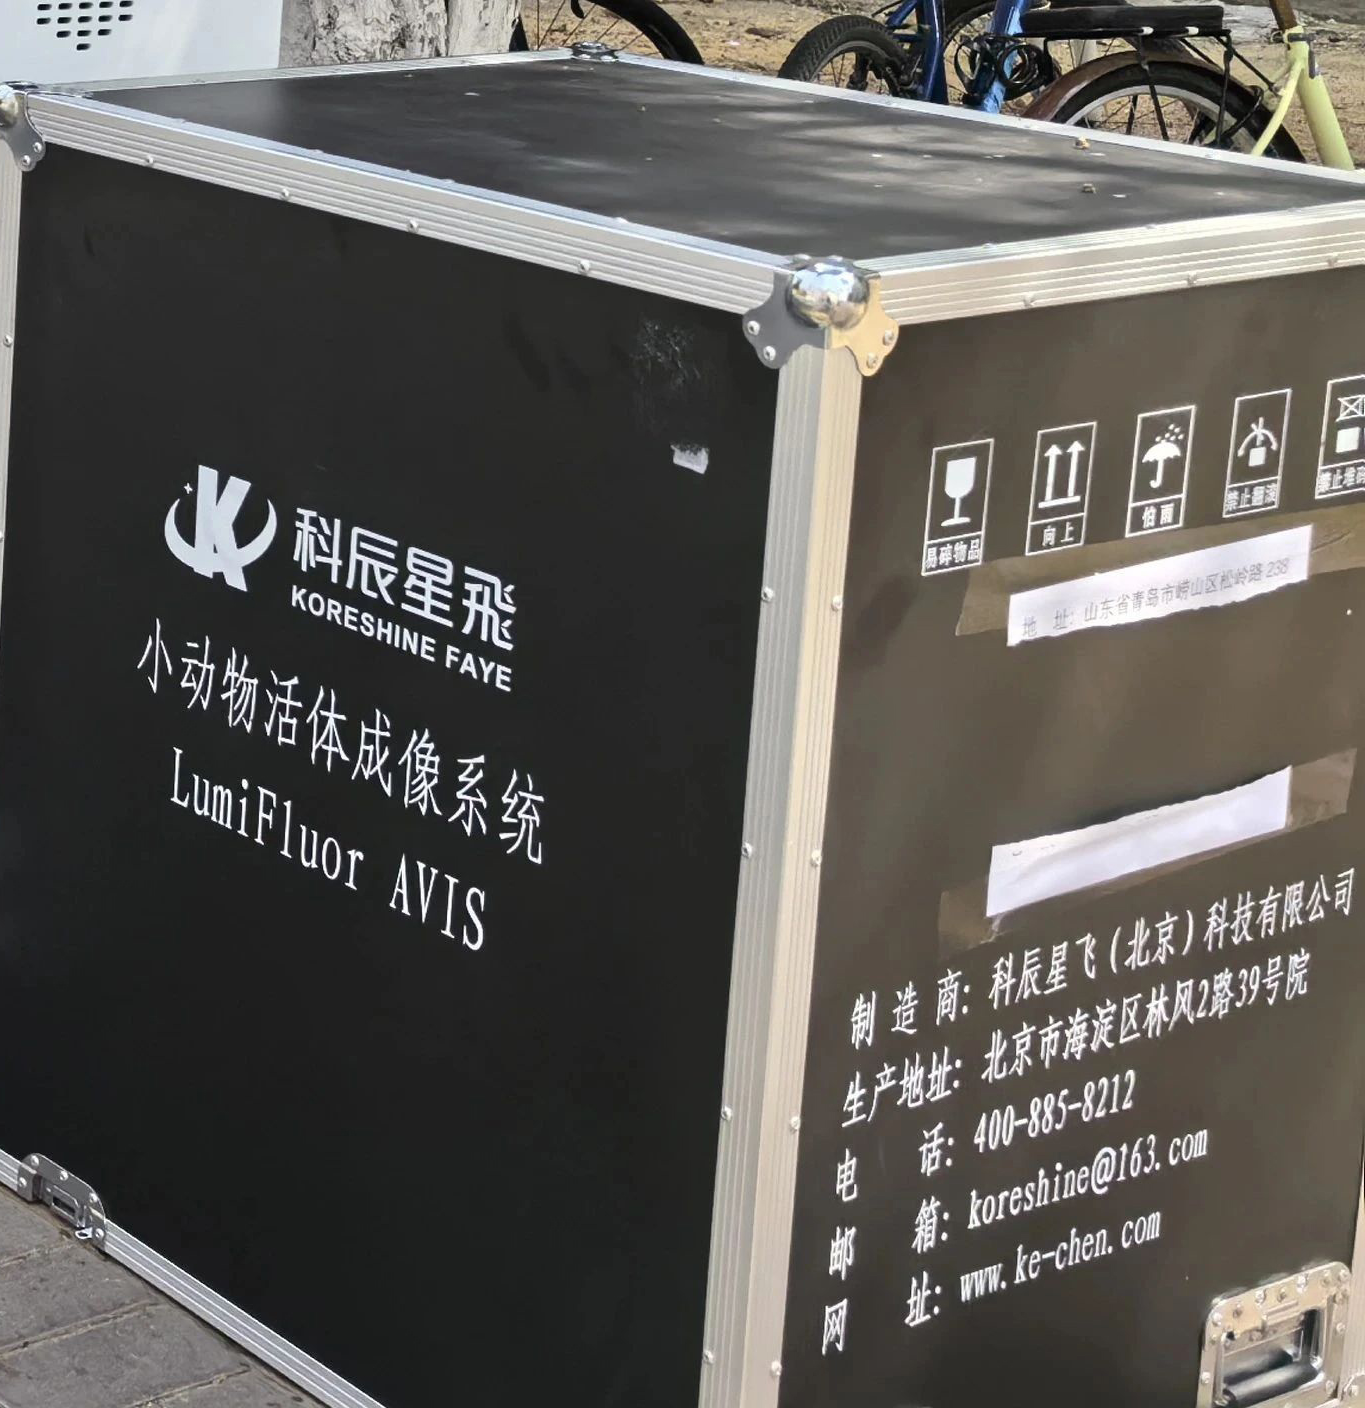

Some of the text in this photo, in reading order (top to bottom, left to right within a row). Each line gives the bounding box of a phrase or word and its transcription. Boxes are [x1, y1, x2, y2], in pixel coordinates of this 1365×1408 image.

[292, 507, 517, 651] 科辰星飛
[925, 537, 981, 569] 易碎物品
[1042, 521, 1075, 547] 向上
[291, 584, 512, 692] KORESHINE FAYE
[136, 617, 545, 865] 小动物活体成像系统
[170, 746, 486, 951] LumiFluor AVIS
[981, 953, 1312, 1084] 北京市海淀区林风2路39号院
[973, 1069, 1137, 1154] 400-885-8212
